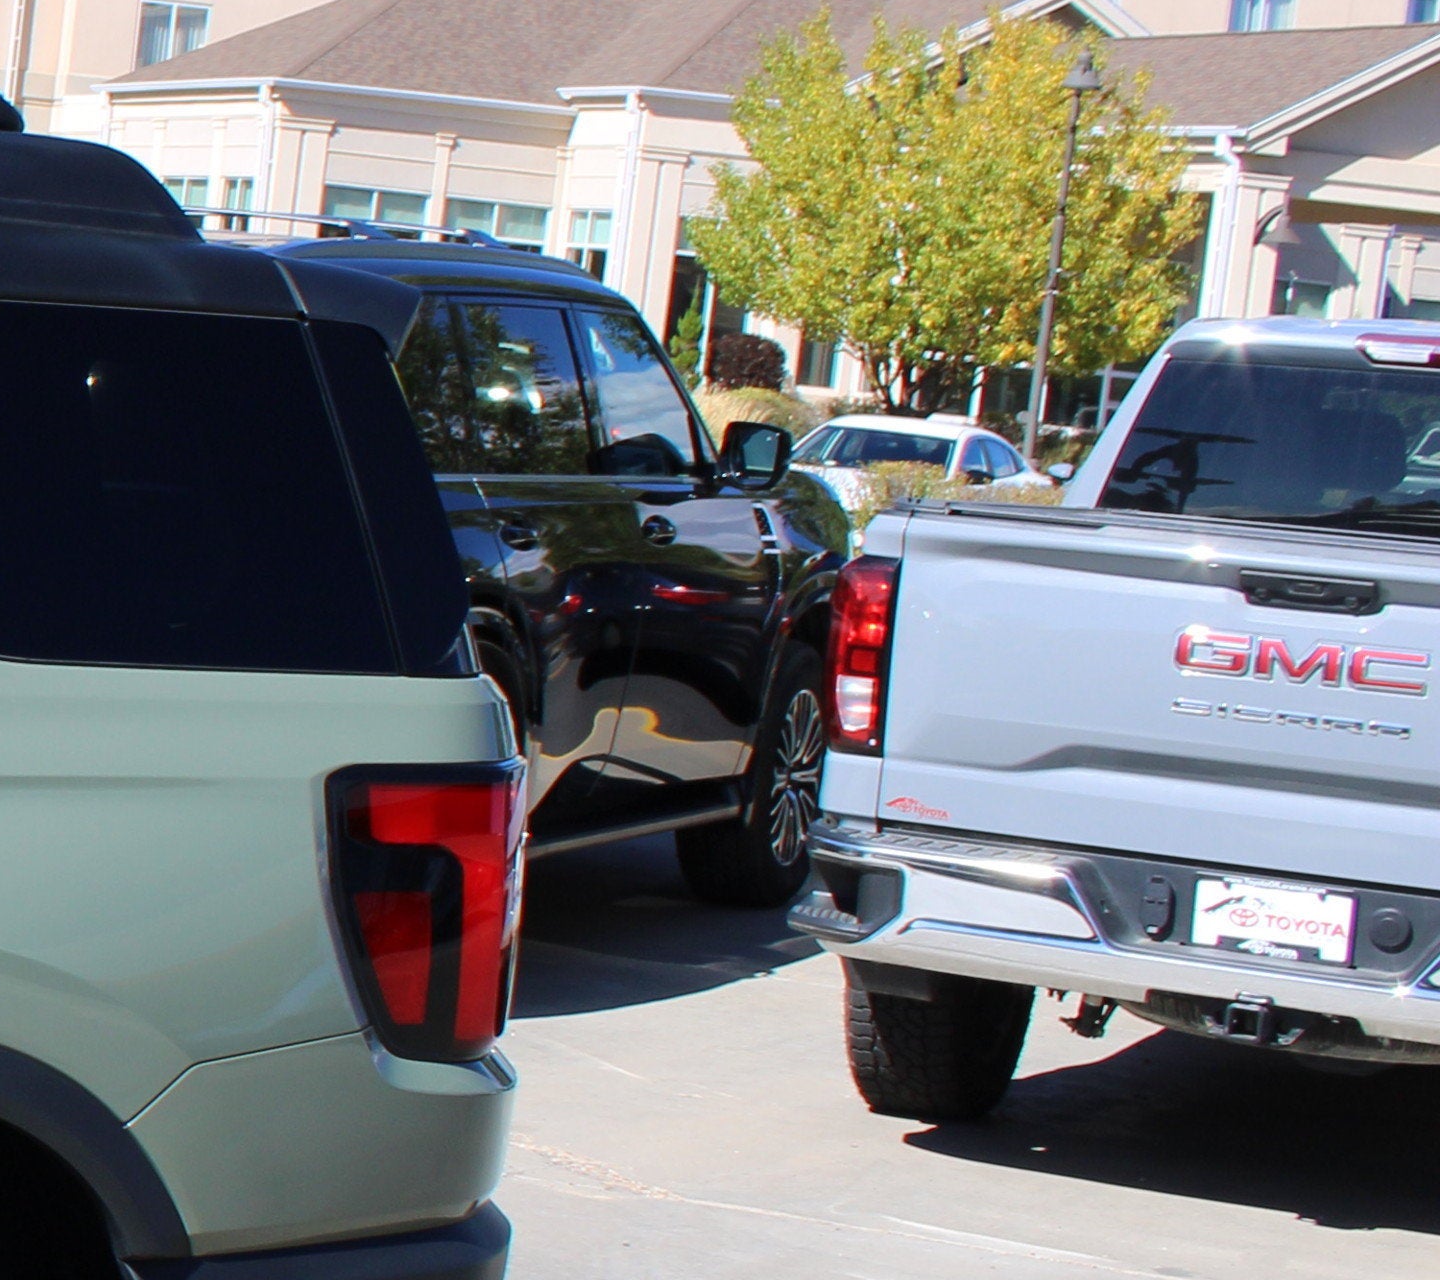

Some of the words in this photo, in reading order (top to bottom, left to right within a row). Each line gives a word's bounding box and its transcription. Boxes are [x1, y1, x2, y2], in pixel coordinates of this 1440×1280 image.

[1174, 624, 1431, 699] GMC
[1170, 696, 1411, 740] SIERRA
[913, 805, 949, 819] TOYOTA
[1264, 914, 1347, 938] TOYOTA
